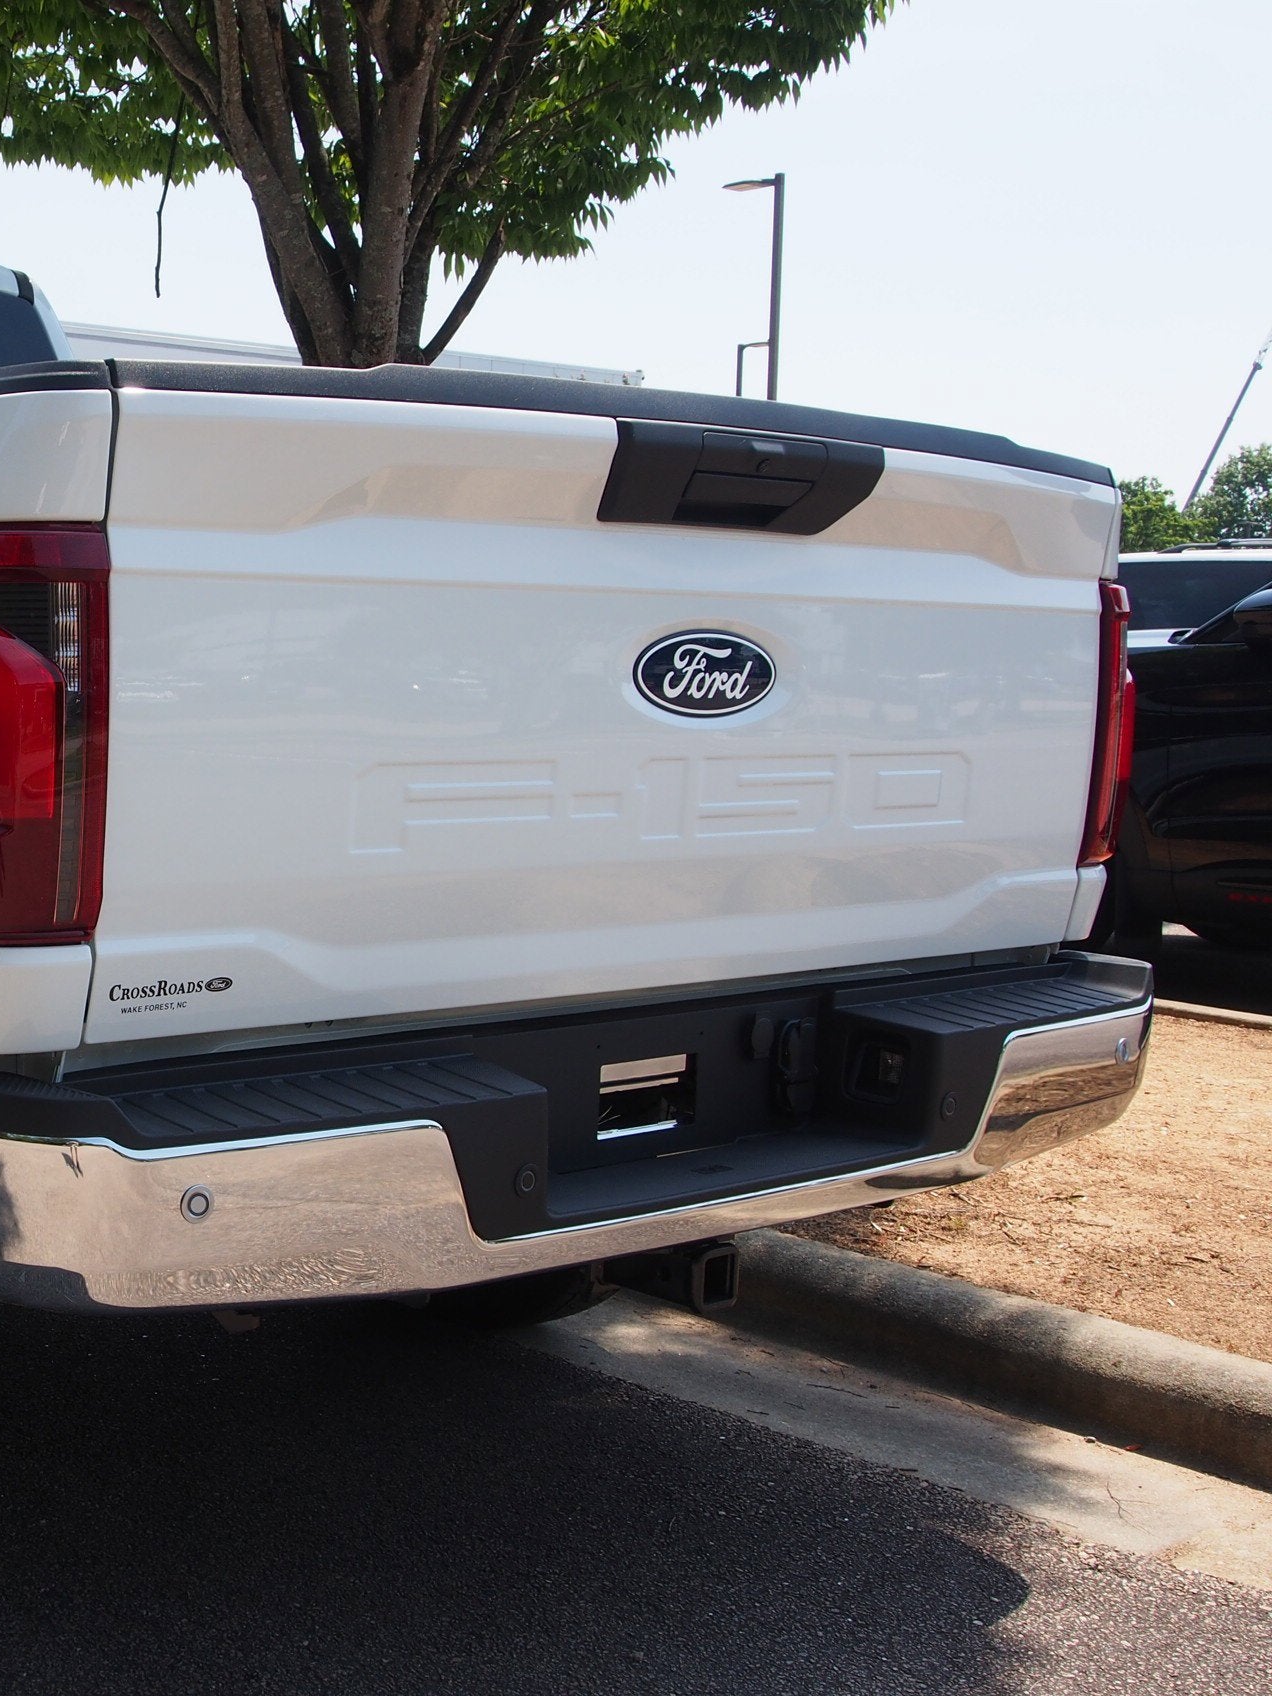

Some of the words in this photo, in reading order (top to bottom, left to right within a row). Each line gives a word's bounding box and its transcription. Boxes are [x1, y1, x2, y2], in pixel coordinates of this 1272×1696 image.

[662, 643, 753, 700] Ford
[345, 751, 972, 854] F-150
[120, 1005, 143, 1015] WAKE
[144, 1002, 175, 1012] FOREST,
[176, 1001, 188, 1009] NC
